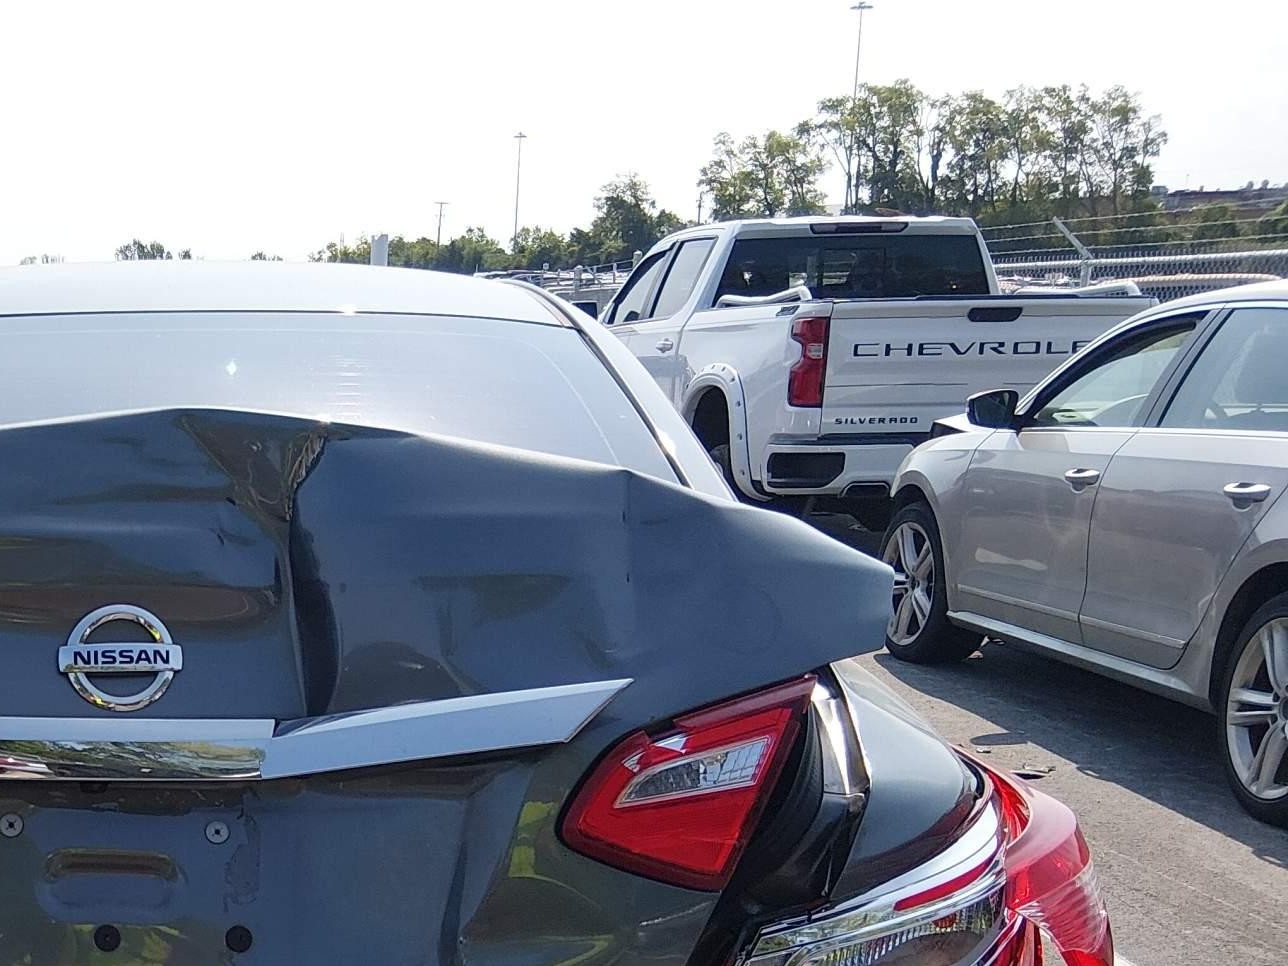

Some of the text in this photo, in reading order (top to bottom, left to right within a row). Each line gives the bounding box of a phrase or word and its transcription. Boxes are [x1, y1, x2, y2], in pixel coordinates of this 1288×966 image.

[853, 341, 1092, 357] CHEVROLE
[834, 416, 918, 425] SILVERADO
[73, 649, 170, 665] NISSAN
